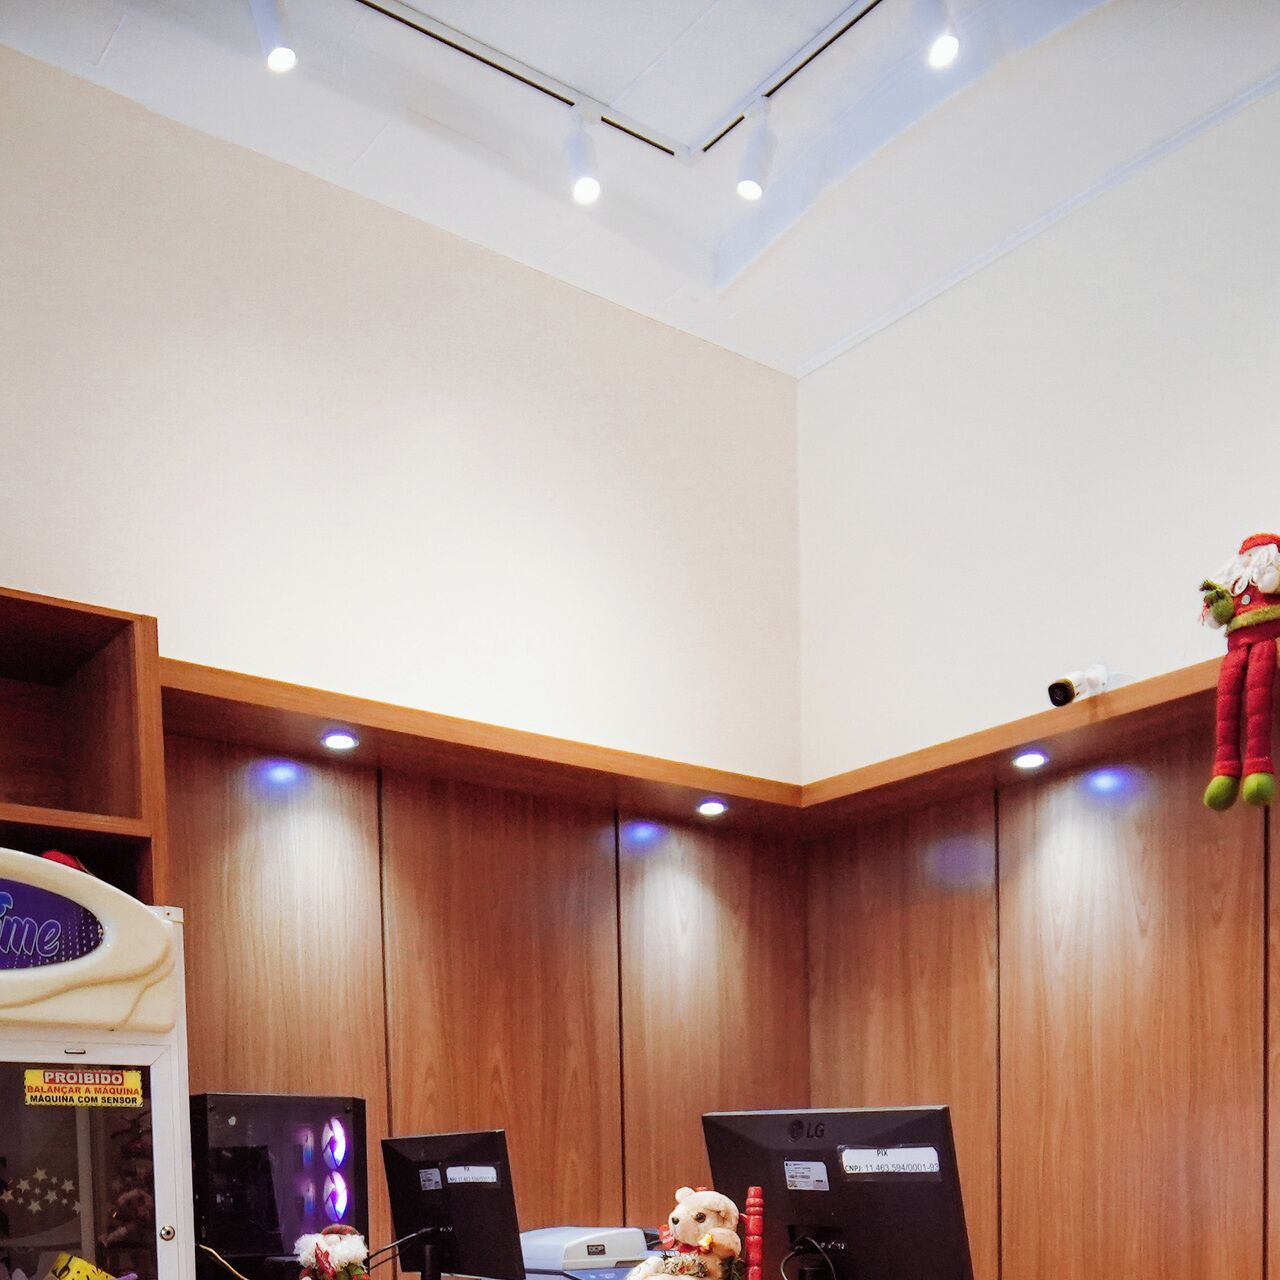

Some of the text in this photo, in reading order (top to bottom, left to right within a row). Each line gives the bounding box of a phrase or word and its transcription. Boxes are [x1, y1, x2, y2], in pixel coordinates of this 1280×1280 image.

[44, 1071, 123, 1084] PROIBIDO
[27, 1085, 81, 1095] BALANÇAR
[84, 1086, 91, 1094] A
[77, 1095, 98, 1103] COM
[101, 1096, 137, 1104] SENSOR
[806, 1121, 825, 1138] LG
[876, 1149, 888, 1157] PIX
